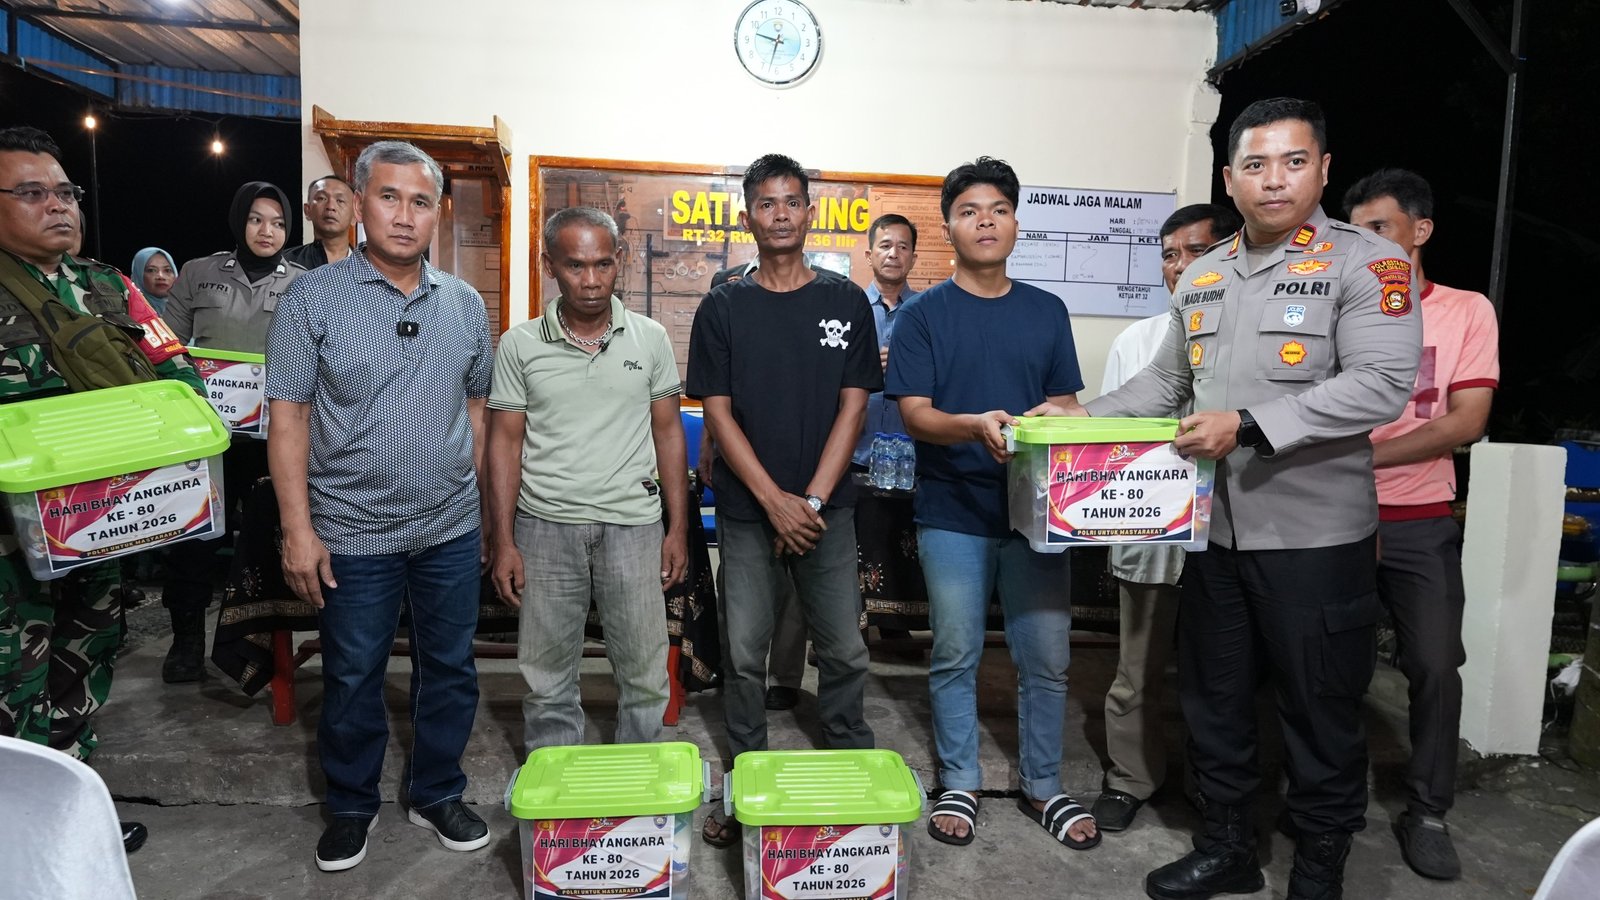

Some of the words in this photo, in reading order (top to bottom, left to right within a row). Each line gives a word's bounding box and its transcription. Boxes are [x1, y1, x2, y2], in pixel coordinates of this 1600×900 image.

[760, 10, 768, 18] 11
[774, 6, 782, 16] 12
[792, 12, 795, 20] 1
[751, 20, 760, 30] 10
[802, 24, 806, 32] 2
[744, 36, 750, 44] 9
[806, 39, 810, 47] 3
[748, 50, 754, 59] 8
[800, 53, 805, 61] 4
[774, 67, 779, 75] 6
[1027, 192, 1070, 206] JADWAL
[1073, 195, 1101, 208] JAGA
[1104, 197, 1142, 210] MALAM
[682, 228, 726, 243] RT.32
[1026, 232, 1048, 240] NAMA
[198, 282, 229, 292] PUTRI
[1273, 282, 1331, 296] POLRI
[1184, 292, 1201, 306] MADE
[1200, 288, 1226, 303] BUDHI
[205, 378, 258, 390] YANGKARA
[210, 391, 224, 400] 80
[215, 404, 236, 414] 026
[1056, 470, 1087, 482] HARI
[1090, 469, 1189, 482] BHAYANGKARA
[49, 502, 87, 518] HARI
[91, 477, 201, 510] BHAYANGKARA
[1101, 489, 1117, 500] KE
[1127, 488, 1144, 500] 80
[107, 511, 125, 522] KE
[138, 504, 156, 516] 80
[1082, 507, 1126, 519] TAHUN
[1129, 506, 1161, 518] 2026
[88, 520, 140, 542] TAHUN
[142, 514, 177, 528] 2026
[540, 838, 569, 848] HARI
[572, 836, 665, 848] BHAYANGKARA
[768, 849, 796, 859] HARI
[800, 845, 890, 859] BHAYANGKARA
[583, 854, 598, 864] KE
[608, 854, 622, 864] 80
[810, 865, 824, 874] KE
[834, 864, 849, 874] 80
[566, 870, 606, 880] TAHUN
[610, 869, 640, 880] 2026
[793, 880, 834, 891] TAHUN
[836, 878, 866, 889] 2026
